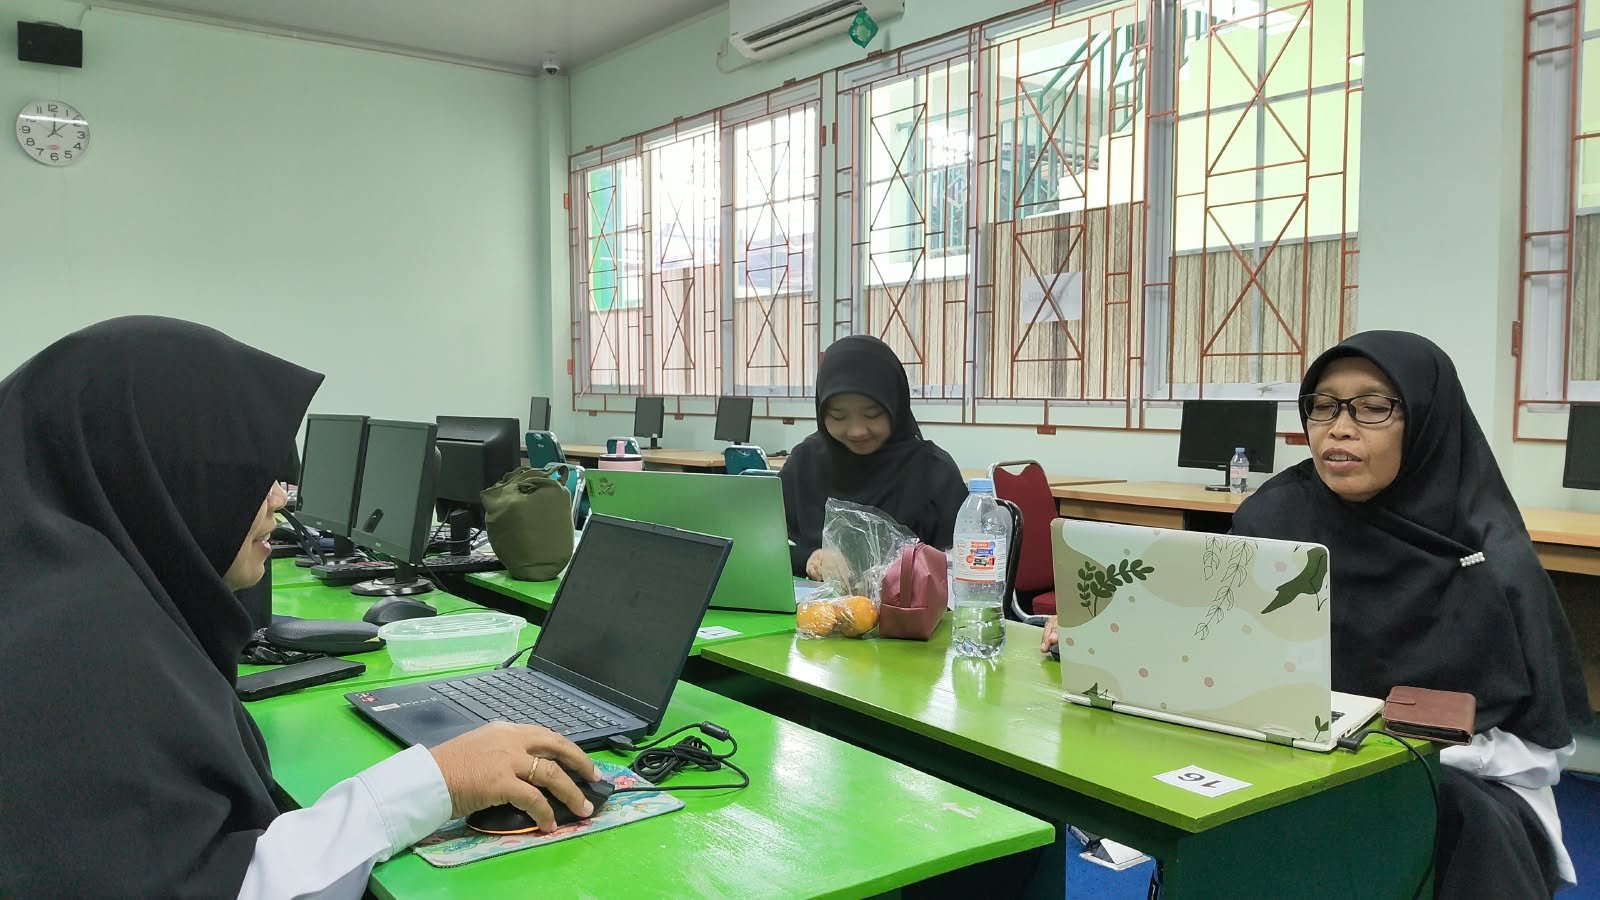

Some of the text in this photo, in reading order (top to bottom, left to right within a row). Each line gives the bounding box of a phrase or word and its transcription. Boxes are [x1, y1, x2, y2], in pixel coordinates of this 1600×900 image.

[37, 106, 42, 114] 11
[48, 104, 58, 112] 12
[22, 125, 31, 134] 9
[77, 131, 86, 139] 3
[26, 138, 35, 146] 8
[73, 142, 82, 150] 4
[36, 147, 45, 156] 7
[64, 150, 73, 159] 5
[50, 152, 59, 161] 6
[1177, 772, 1223, 789] 16
